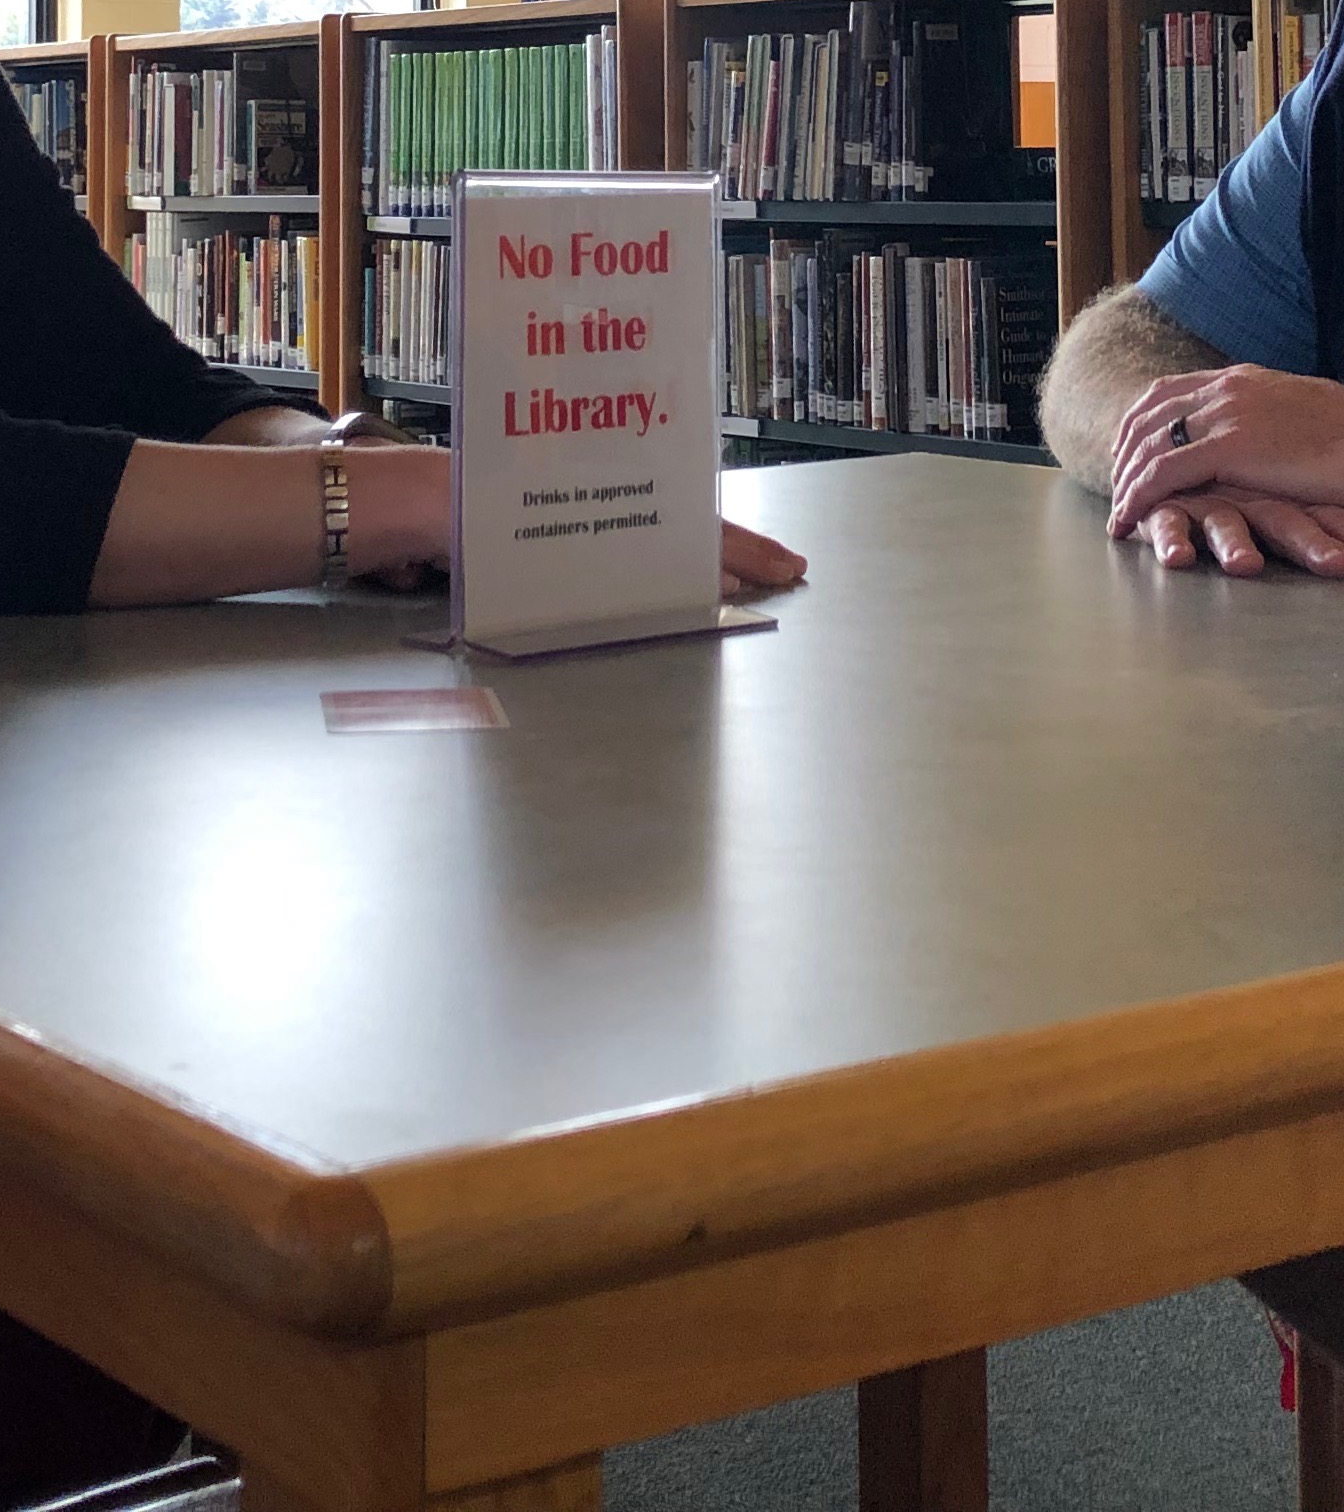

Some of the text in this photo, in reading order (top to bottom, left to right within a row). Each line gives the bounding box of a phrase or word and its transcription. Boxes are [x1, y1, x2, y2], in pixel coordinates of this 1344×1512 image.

[258, 119, 303, 132] Seashre
[498, 229, 669, 280] No Food
[526, 308, 647, 357] in the
[503, 389, 669, 437] Library.
[523, 479, 654, 508] Drinks in approved
[514, 511, 662, 541] containers permitted.
